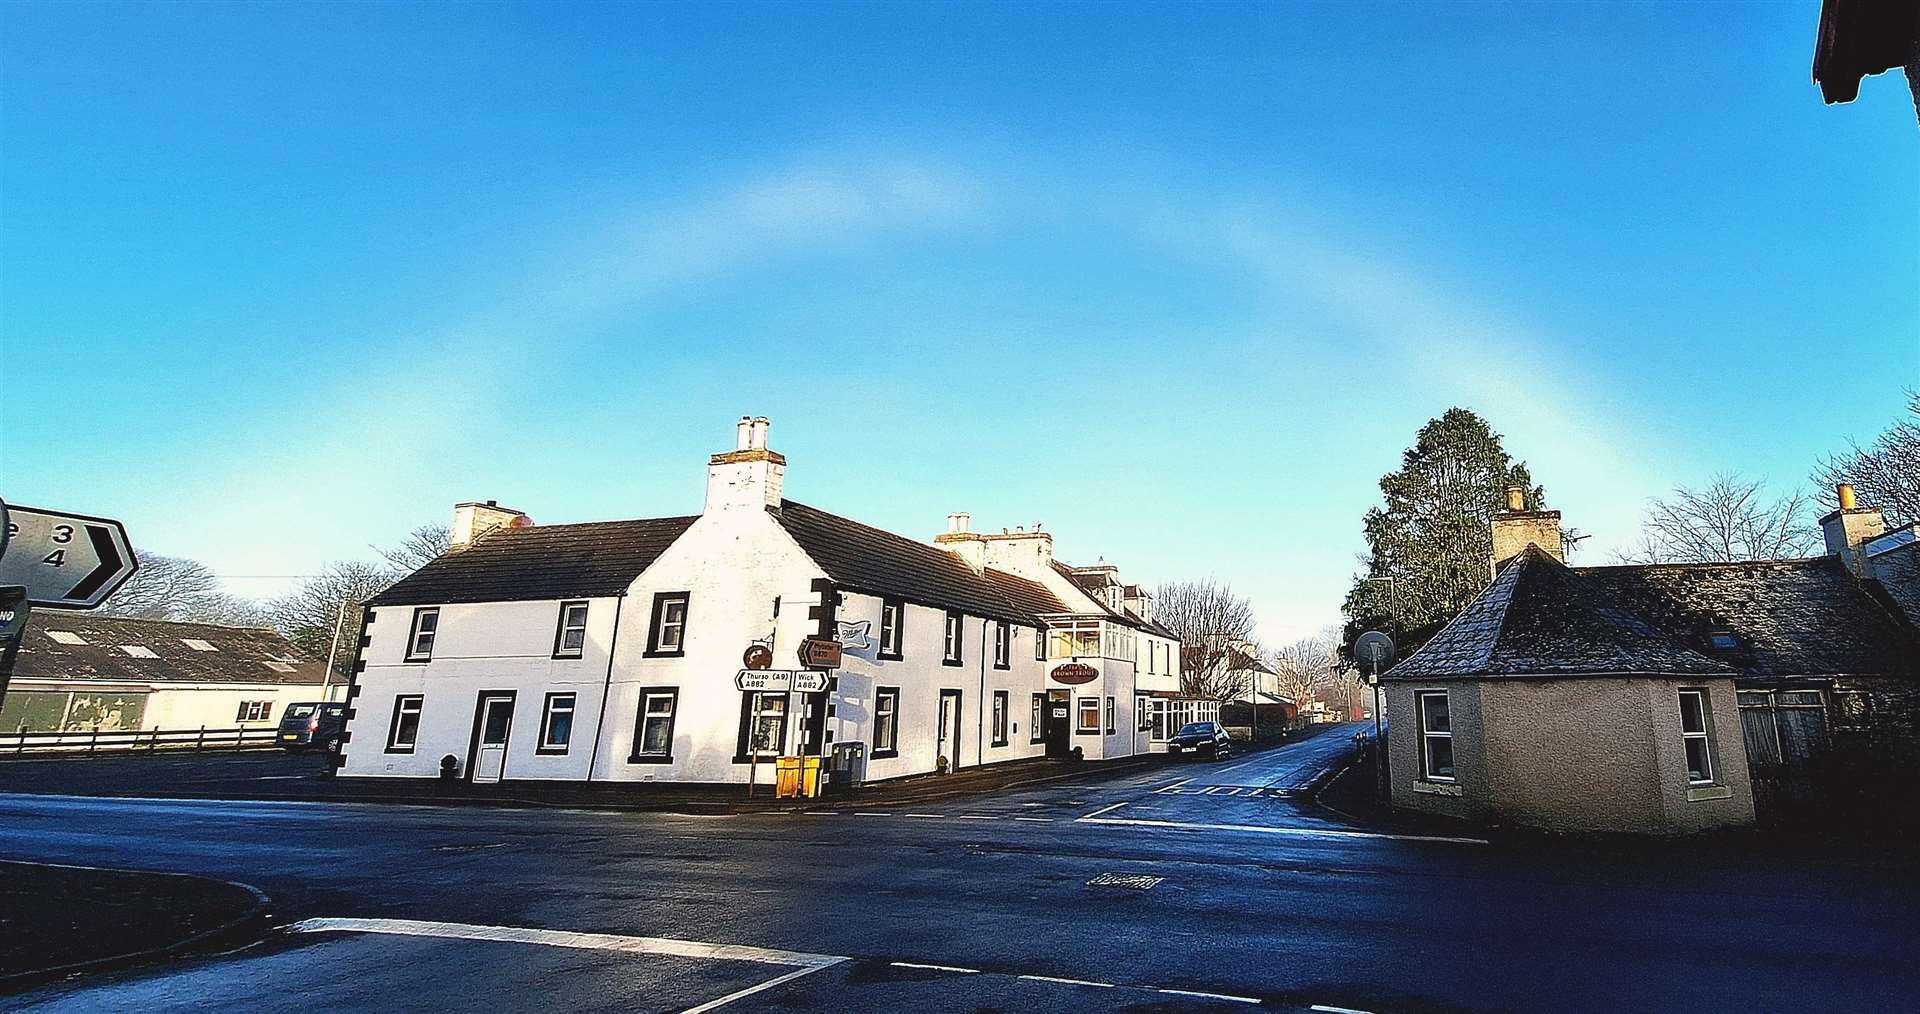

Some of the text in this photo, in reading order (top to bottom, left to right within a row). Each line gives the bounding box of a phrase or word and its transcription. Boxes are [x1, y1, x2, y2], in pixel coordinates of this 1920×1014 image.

[53, 525, 73, 543] 3
[43, 549, 65, 567] 4
[772, 673, 789, 681] (A9)
